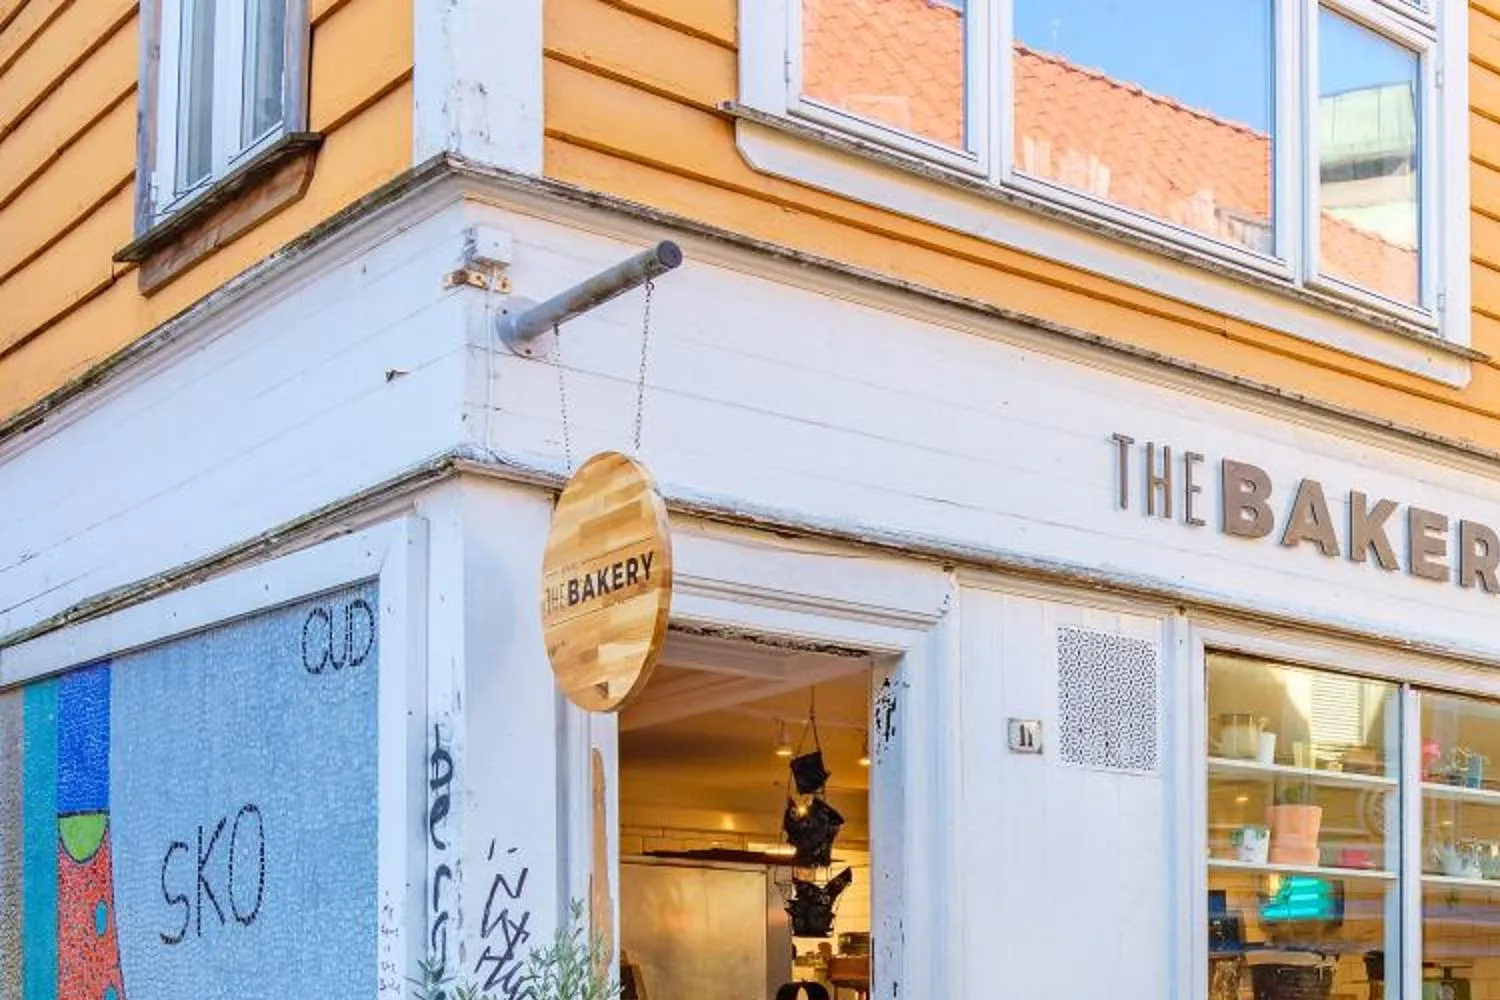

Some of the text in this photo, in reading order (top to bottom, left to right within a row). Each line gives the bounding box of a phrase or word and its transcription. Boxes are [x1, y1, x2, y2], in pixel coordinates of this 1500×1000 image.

[1107, 433, 1207, 527] THE
[546, 551, 654, 613] THE BAKERY
[160, 803, 265, 944] SKO
